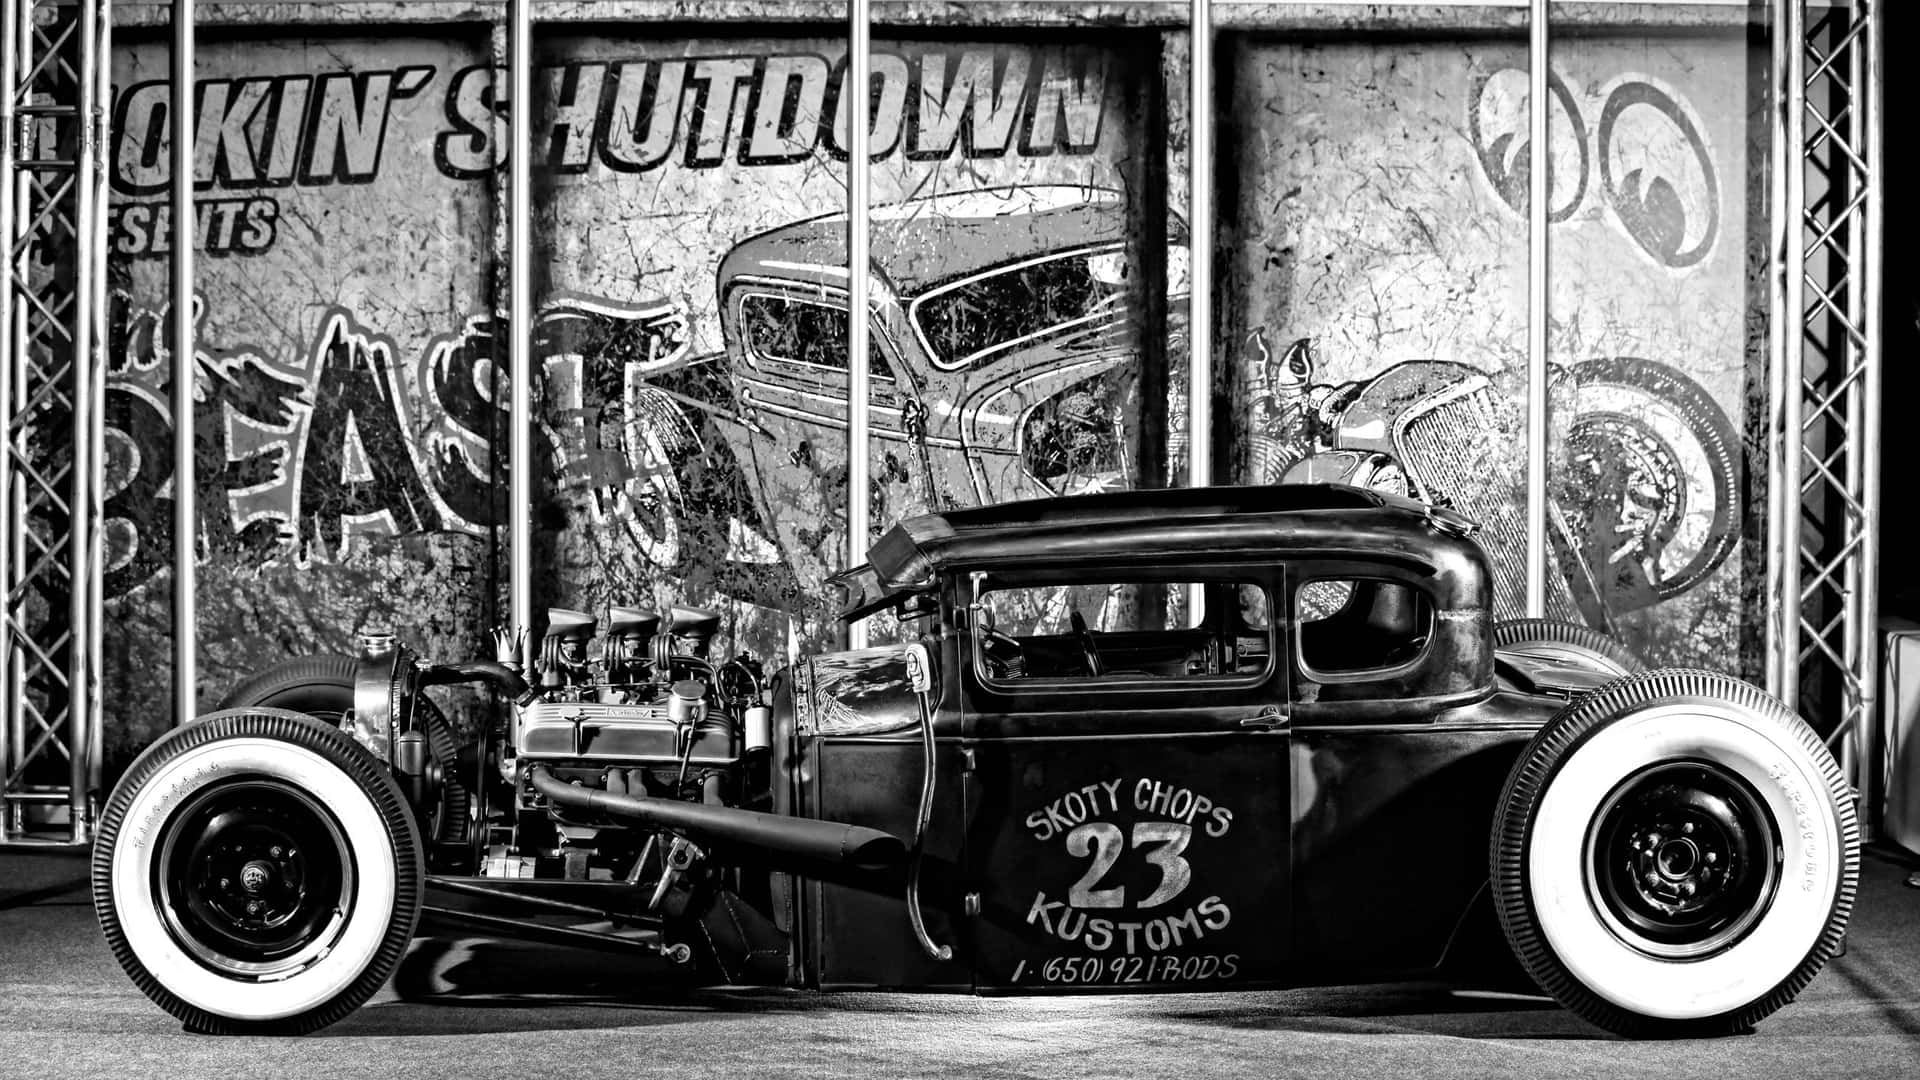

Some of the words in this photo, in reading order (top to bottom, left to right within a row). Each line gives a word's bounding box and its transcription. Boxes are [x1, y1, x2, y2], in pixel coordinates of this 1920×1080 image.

[110, 65, 435, 196] OKIN'
[434, 51, 1108, 179] SHUTDOWN
[1026, 778, 1122, 840] SKOTY
[1134, 778, 1233, 837] CHOPS
[1066, 822, 1192, 909] 23
[1026, 891, 1231, 955] KUSTOMS
